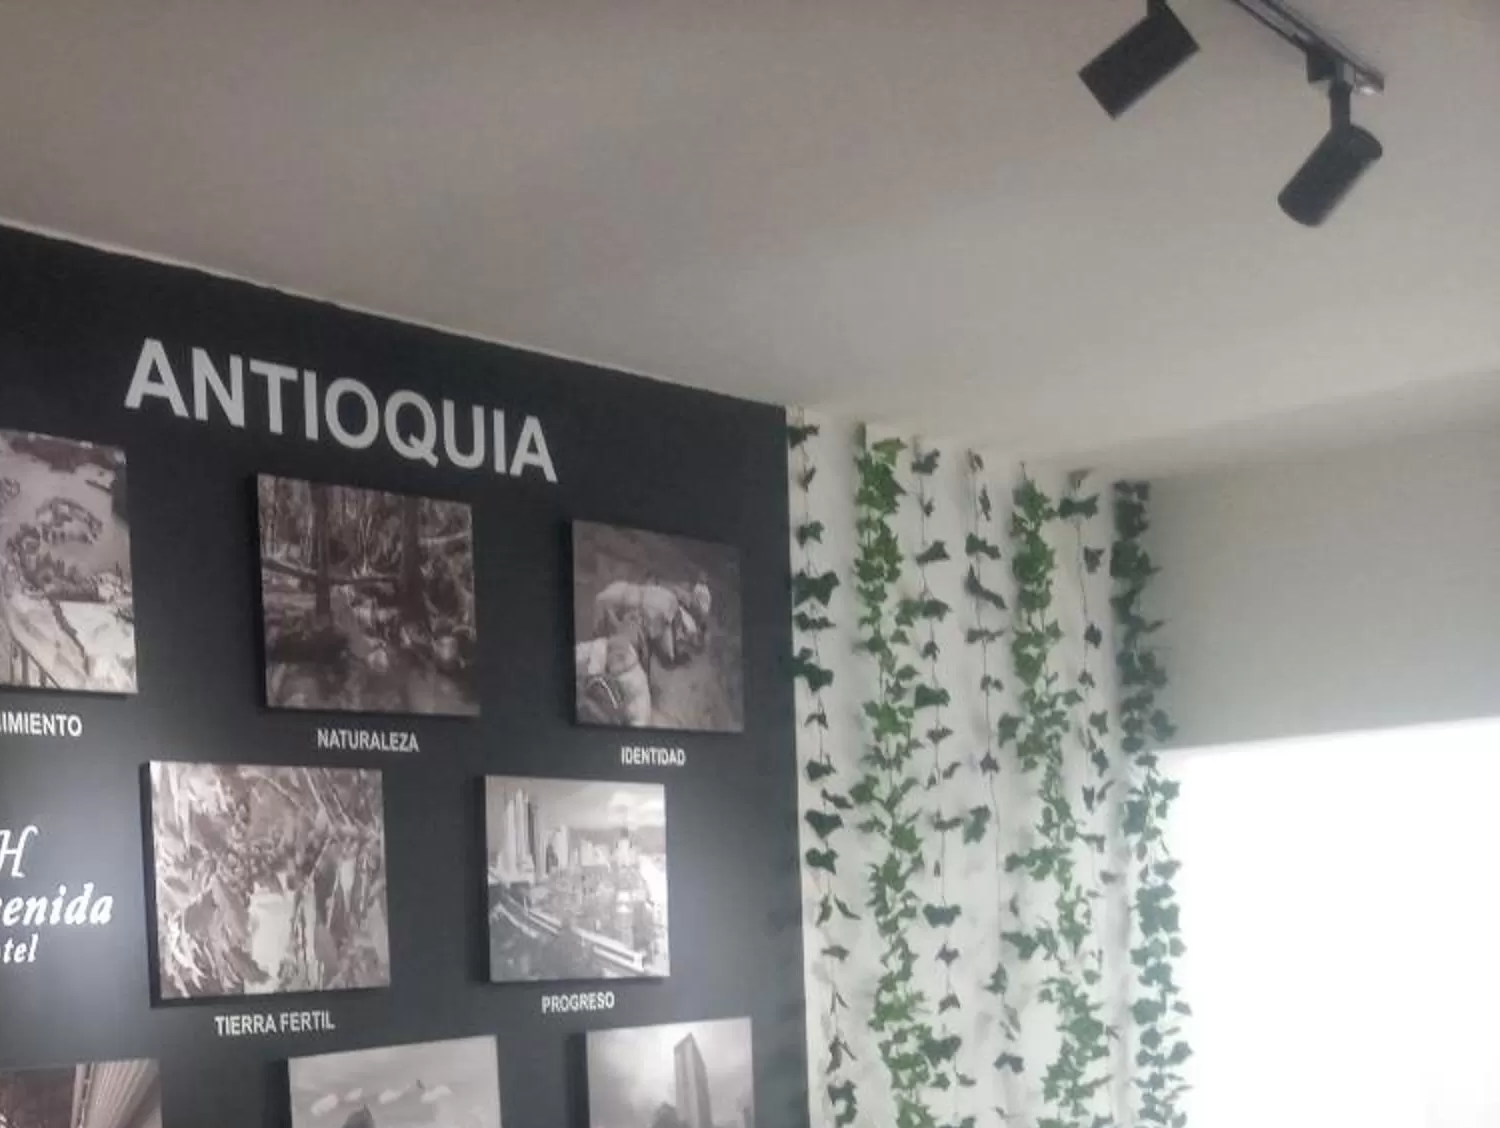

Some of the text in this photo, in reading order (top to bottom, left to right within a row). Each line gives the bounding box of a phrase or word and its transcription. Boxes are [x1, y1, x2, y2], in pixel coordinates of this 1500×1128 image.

[125, 337, 558, 483] ANTIOQUIA
[315, 728, 420, 753] NATURALEZA
[620, 745, 687, 767] IDENTIDAD
[541, 990, 616, 1013] PROGRESO
[214, 1010, 335, 1036] TIERRA FERTIL
